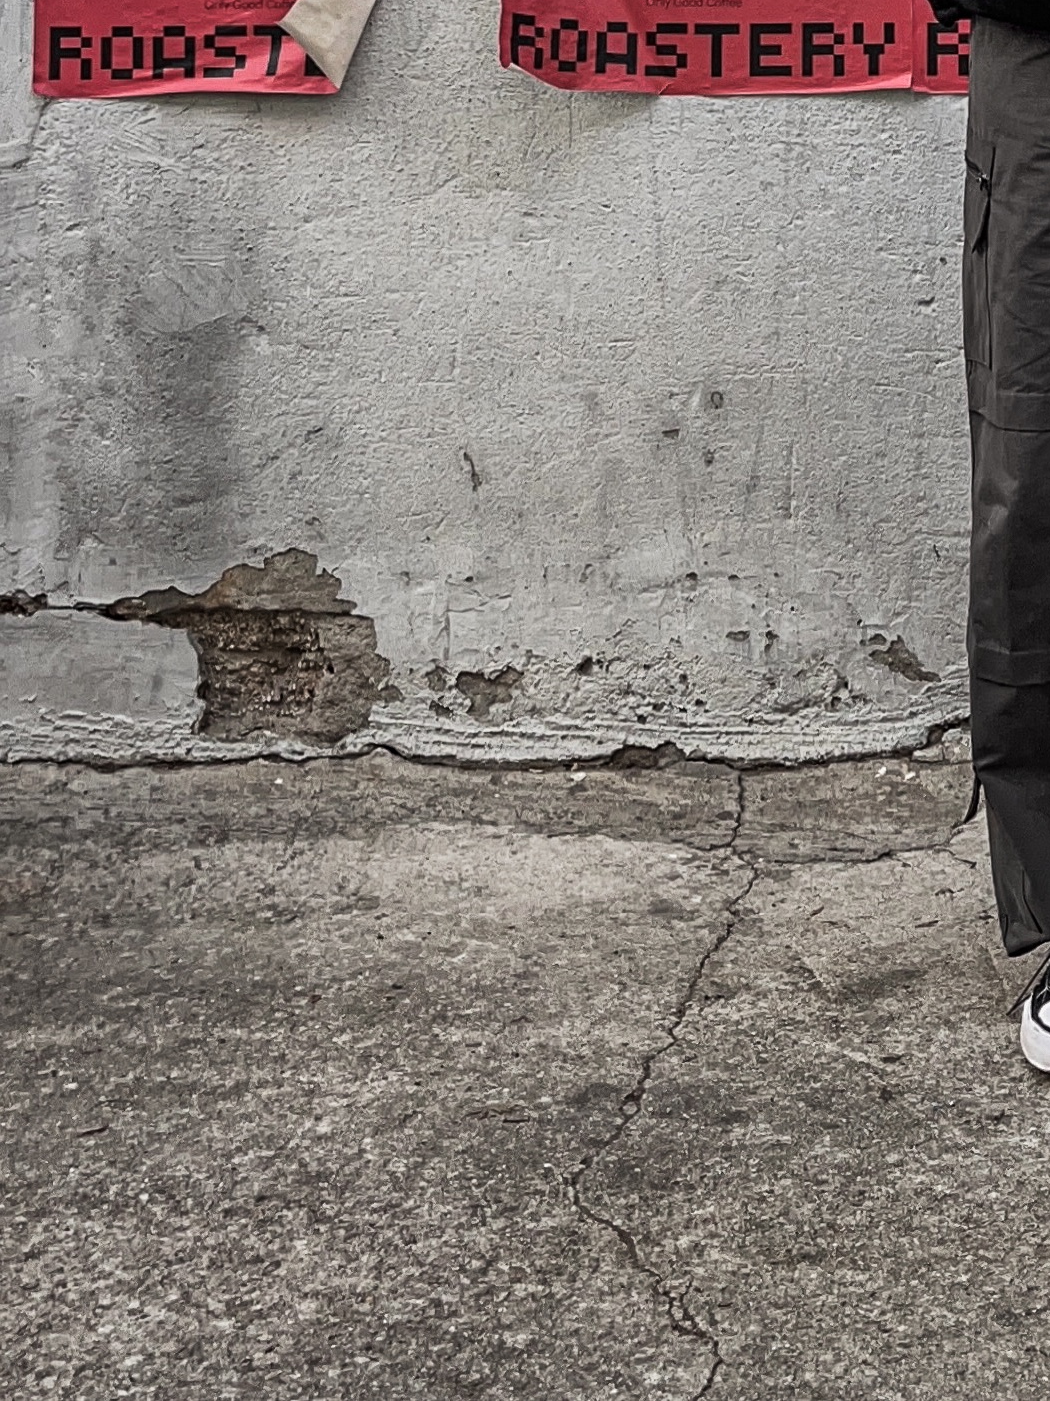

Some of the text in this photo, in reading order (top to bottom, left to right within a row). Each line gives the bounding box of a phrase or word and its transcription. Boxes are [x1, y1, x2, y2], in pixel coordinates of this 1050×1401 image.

[232, 0, 263, 10] Good
[49, 26, 328, 81] ROAST
[510, 12, 895, 78] ROASTERY
